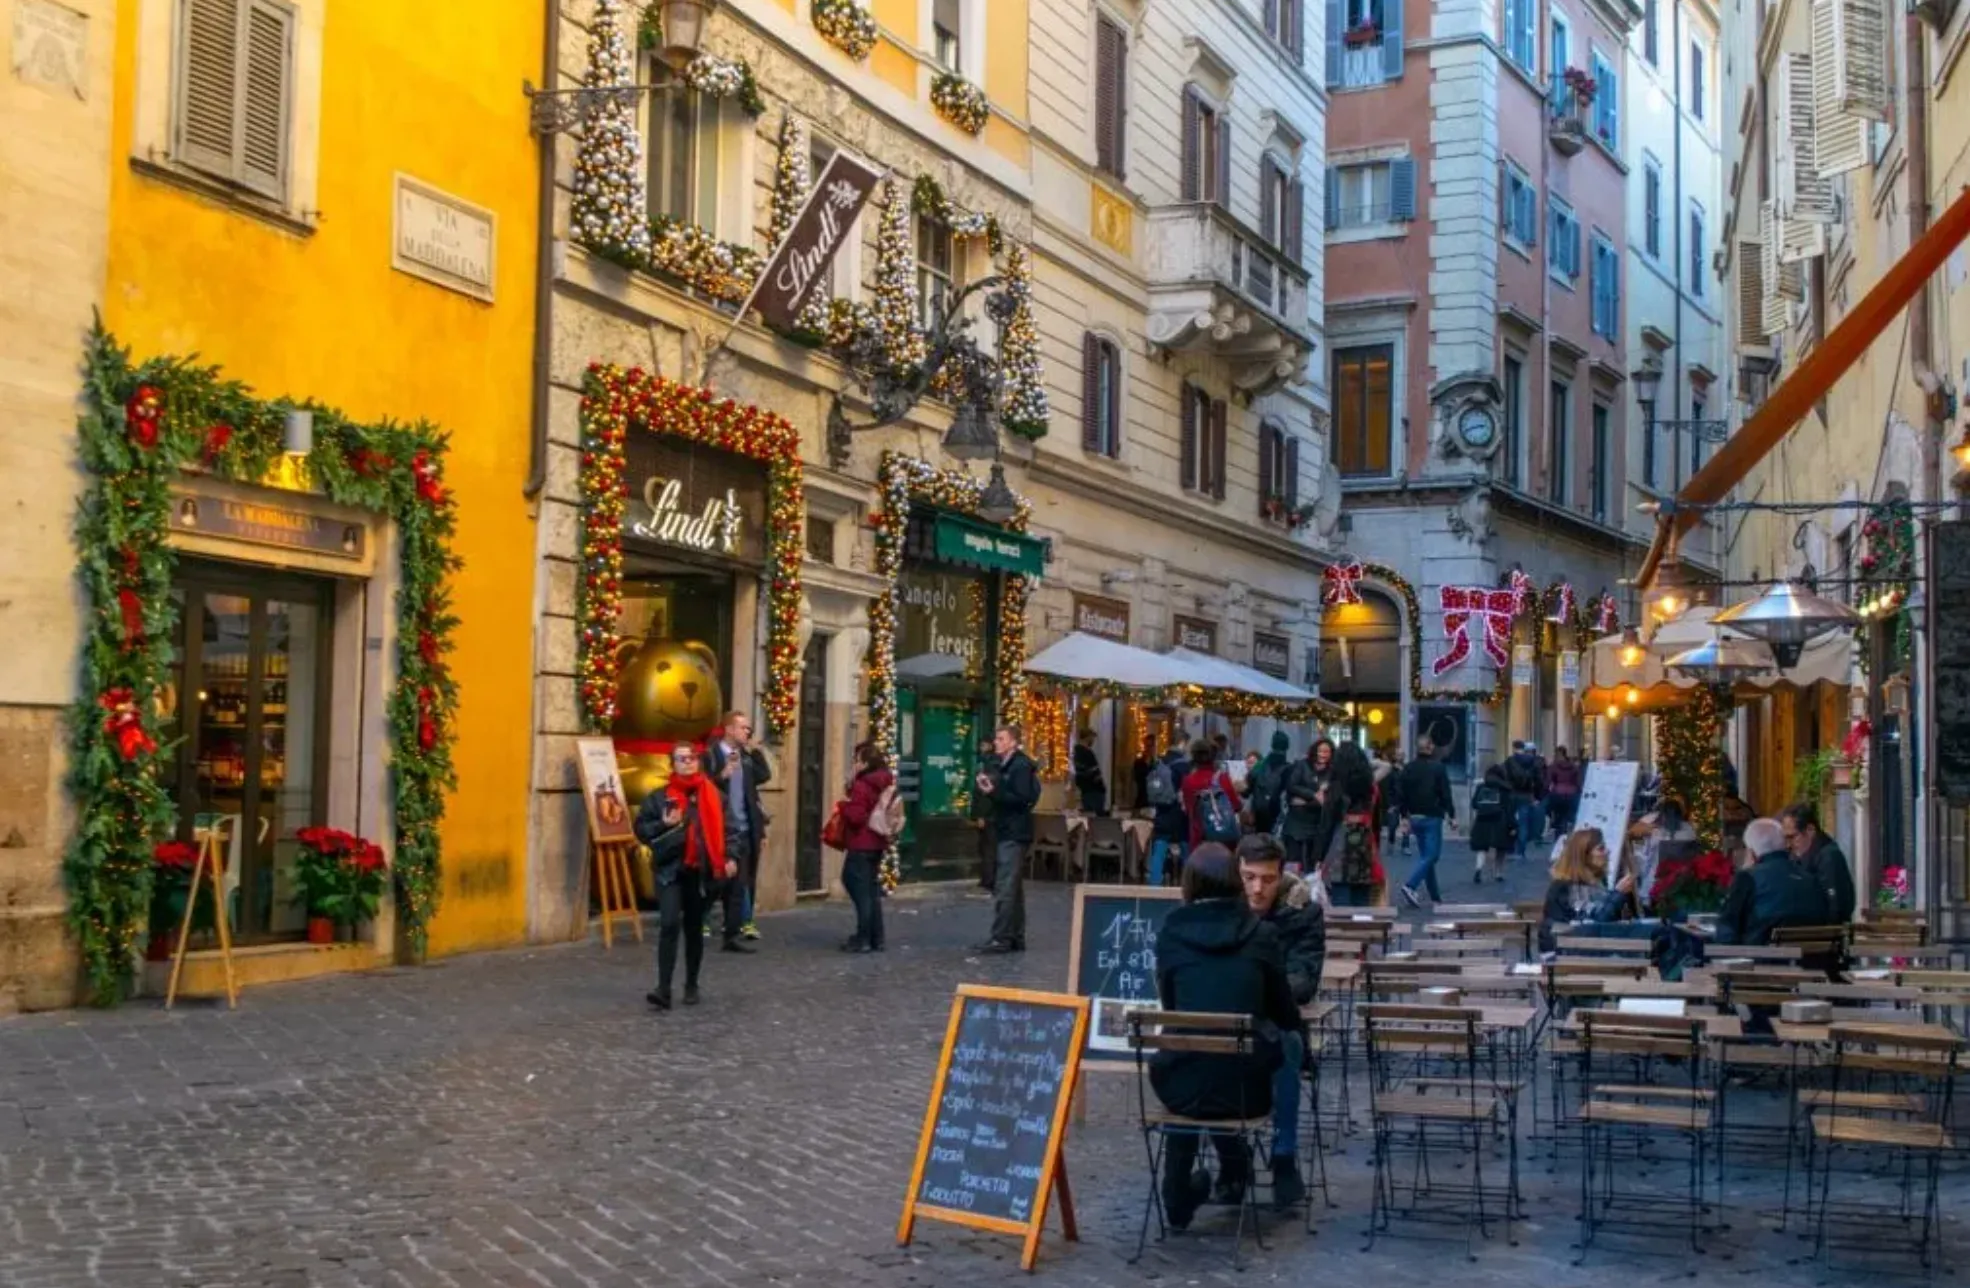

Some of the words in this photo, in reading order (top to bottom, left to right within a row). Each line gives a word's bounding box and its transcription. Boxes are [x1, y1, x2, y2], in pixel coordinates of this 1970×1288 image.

[435, 204, 458, 231] VIA
[404, 235, 488, 284] MADDALENA
[776, 200, 841, 311] Lindt
[632, 476, 718, 550] Lindt
